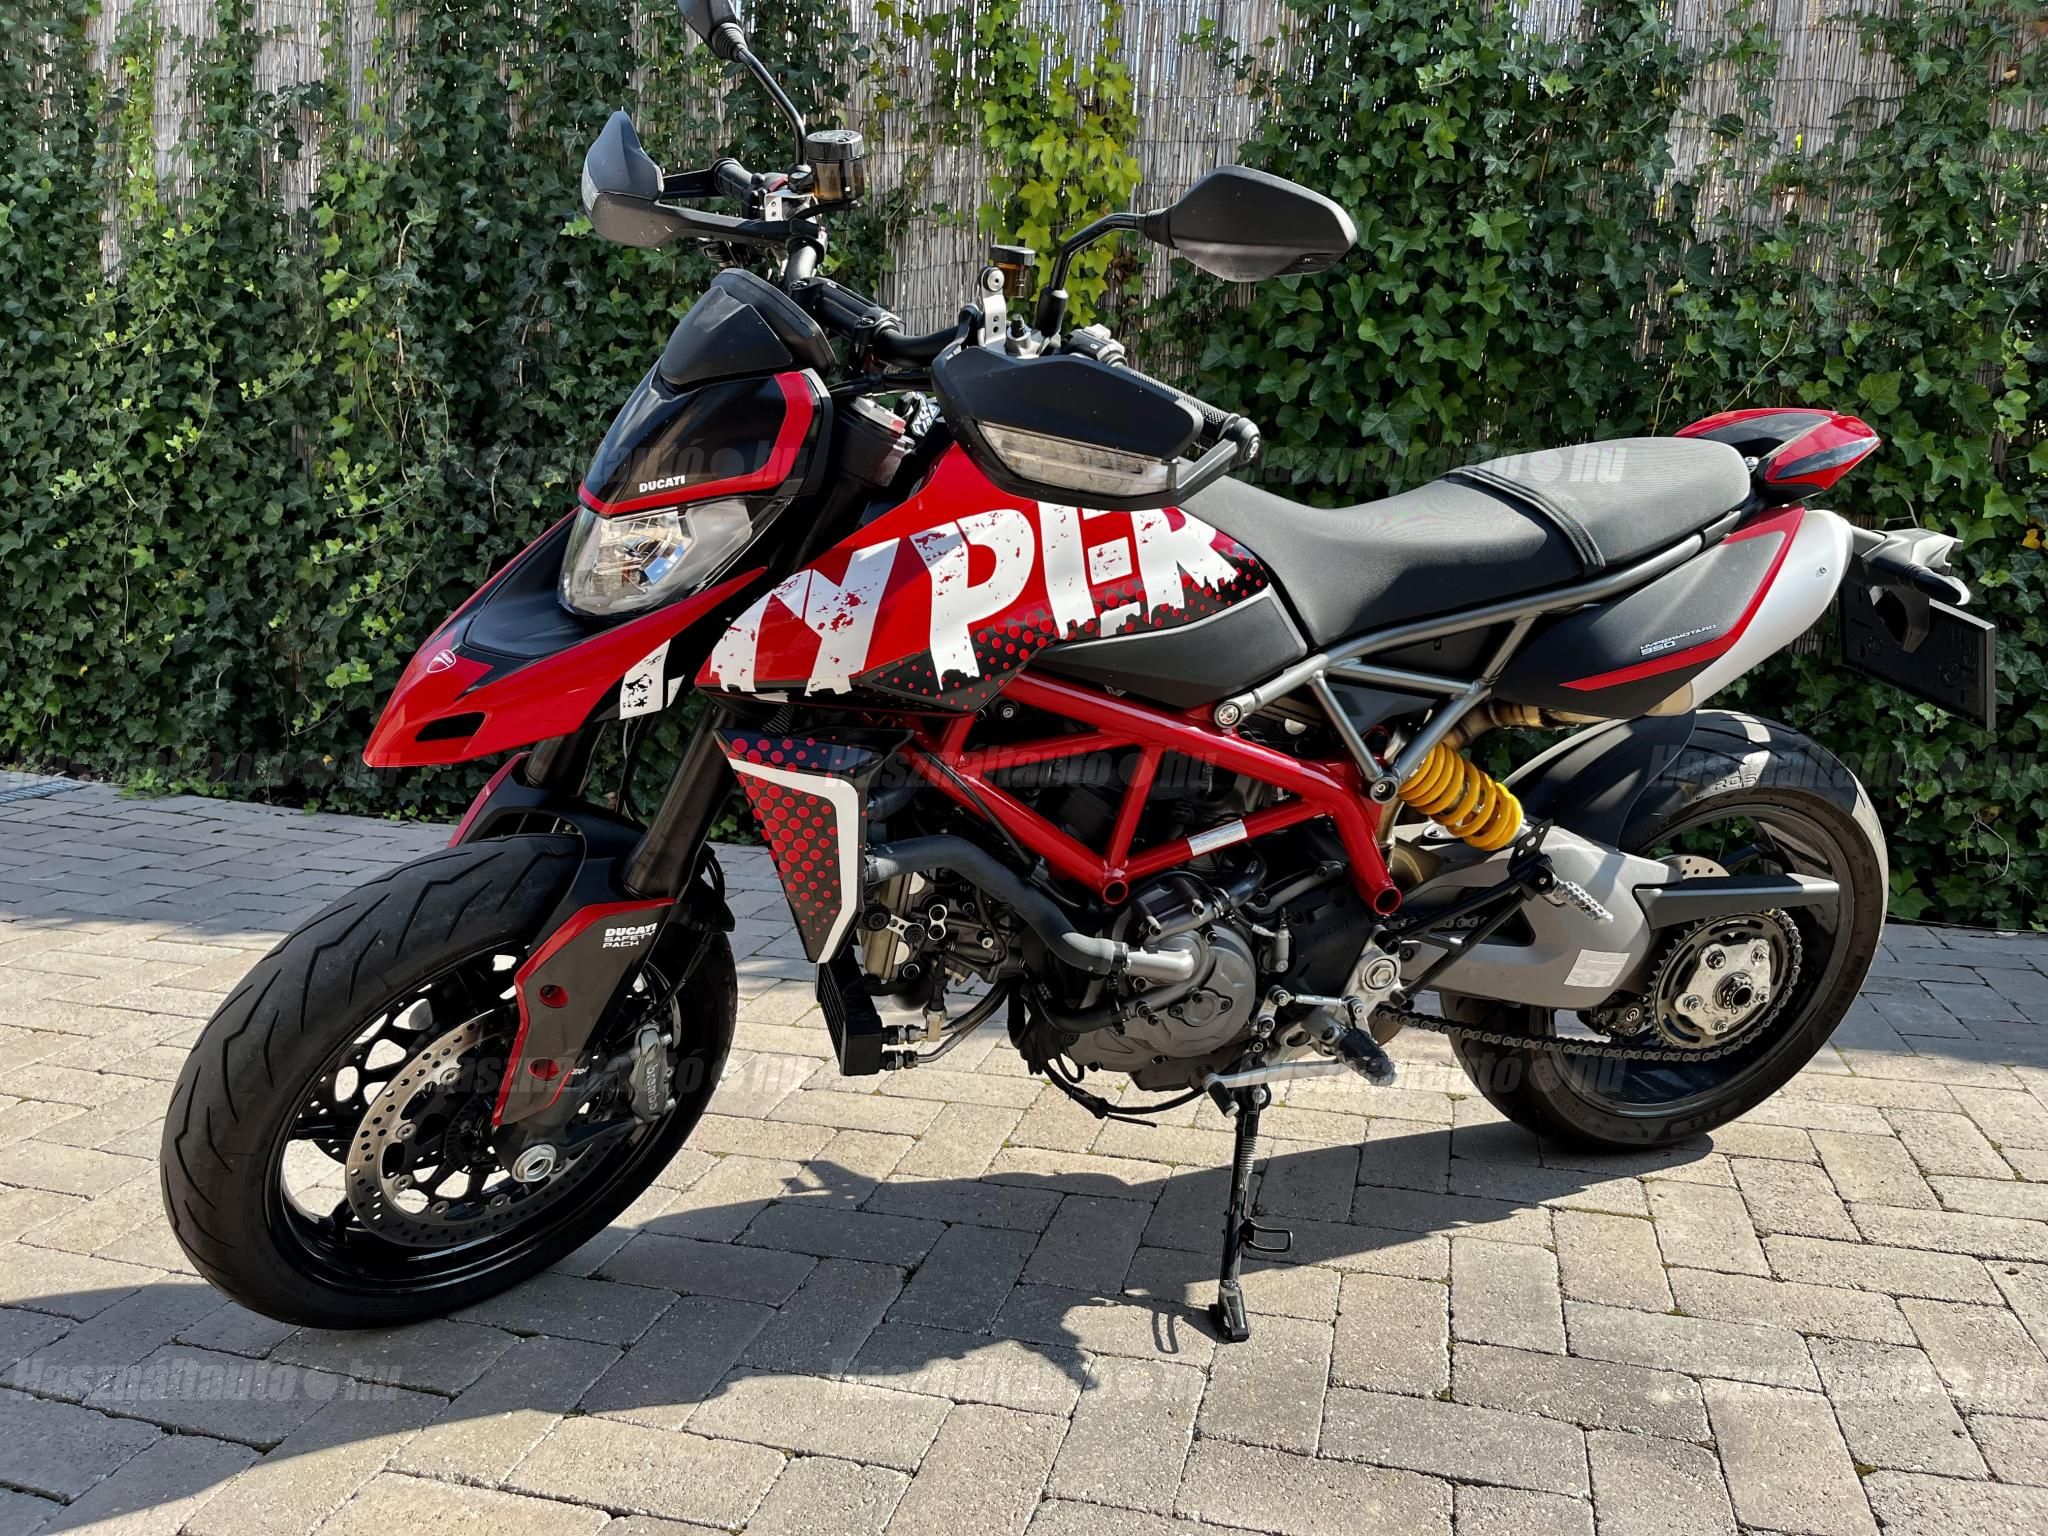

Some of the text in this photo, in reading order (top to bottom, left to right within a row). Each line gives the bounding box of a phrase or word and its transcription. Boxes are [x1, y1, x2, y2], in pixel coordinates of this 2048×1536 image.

[638, 474, 686, 493] DUCATI
[1641, 641, 1676, 656] 950
[603, 931, 656, 943] SAFETY
[604, 922, 658, 937] DUCATI
[602, 940, 640, 949] PACK
[645, 1063, 661, 1111] brembo
